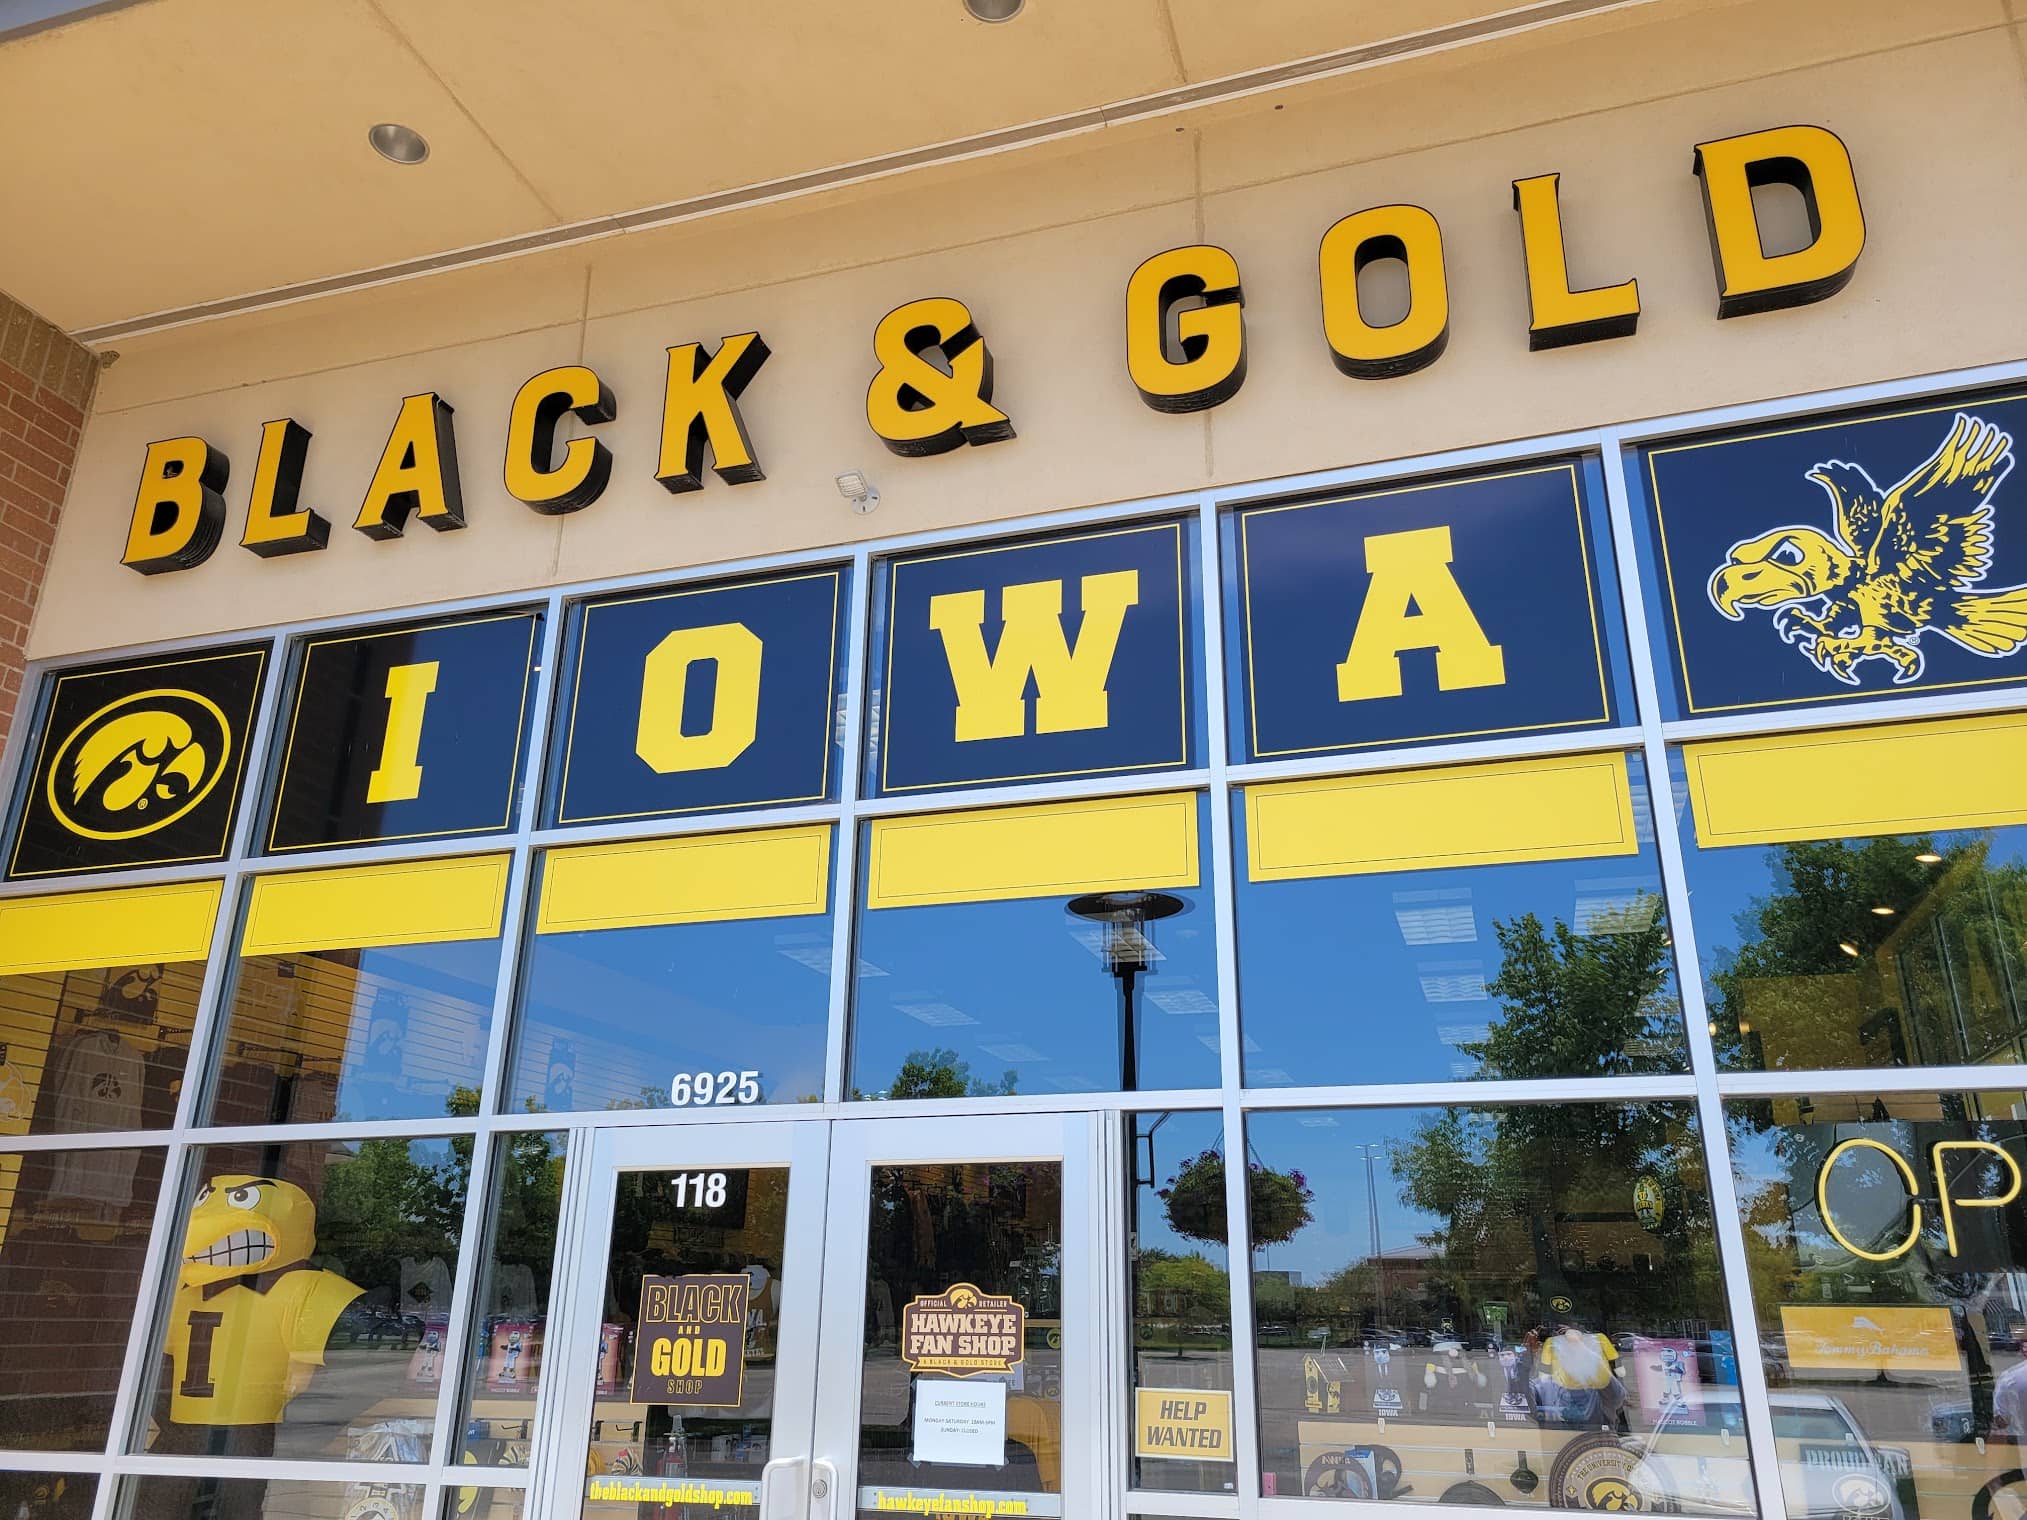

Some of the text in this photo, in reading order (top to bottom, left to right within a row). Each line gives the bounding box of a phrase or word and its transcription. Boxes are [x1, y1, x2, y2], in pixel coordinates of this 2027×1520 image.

[120, 124, 1866, 576] BLACK & GOLD
[366, 525, 1506, 805] IOWA
[671, 1070, 759, 1106] 6925
[671, 1172, 727, 1208] 118
[645, 1284, 743, 1324] BLACK
[919, 1299, 1008, 1308] OFFICIAL RETAILER
[677, 1325, 701, 1335] AND
[911, 1313, 1017, 1333] HAWKEYE
[180, 1310, 224, 1398] I
[650, 1337, 727, 1377] GOLD
[909, 1335, 1017, 1355] FAN SHOP
[666, 1379, 703, 1394] SHOP
[1160, 1400, 1207, 1421] HELP
[1378, 1409, 1399, 1417] IOWA
[1505, 1413, 1526, 1422] IOWA
[1147, 1425, 1222, 1449] WANTED
[589, 1480, 753, 1509] theblackandgoldshop.com
[877, 1489, 1027, 1519] hawkeyefanshop.com
